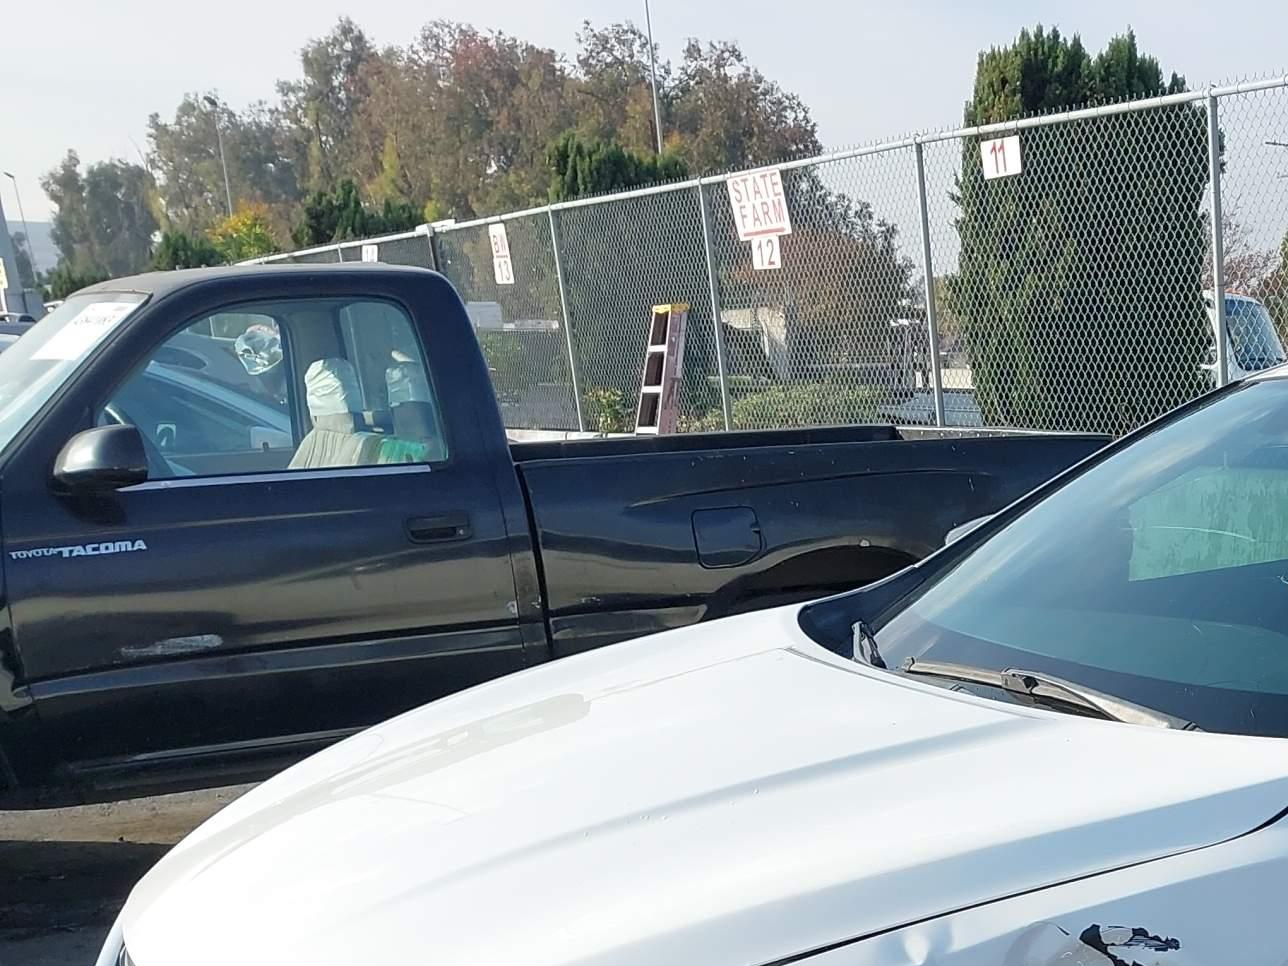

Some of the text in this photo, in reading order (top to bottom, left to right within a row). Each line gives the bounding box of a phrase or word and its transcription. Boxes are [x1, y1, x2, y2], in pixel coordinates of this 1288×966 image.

[989, 139, 1007, 174] 11
[732, 171, 782, 204] STATE
[739, 197, 786, 229] FARM
[757, 238, 776, 267] 12
[9, 539, 147, 560] TOYOTA TACOMA
